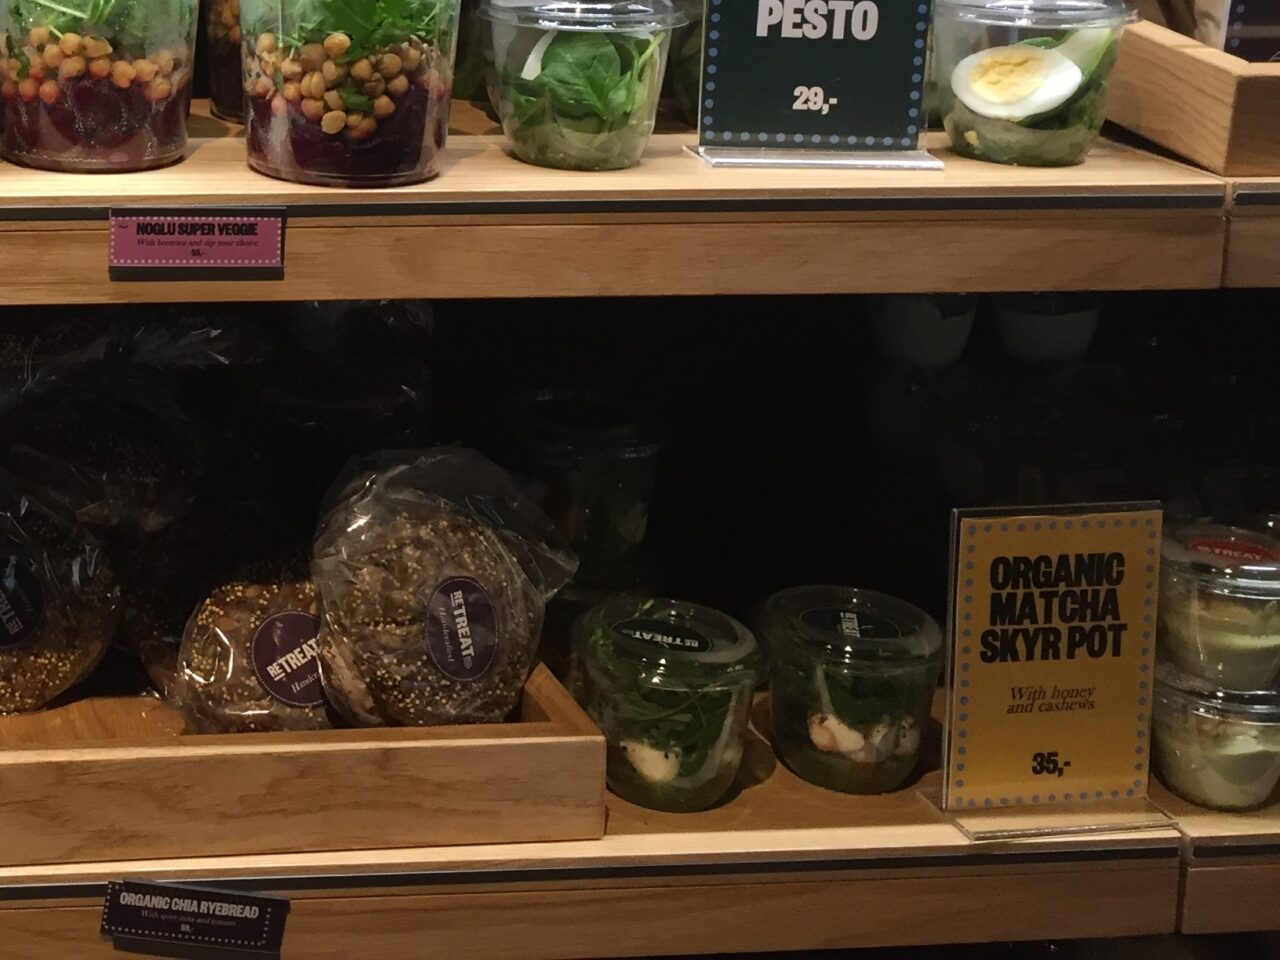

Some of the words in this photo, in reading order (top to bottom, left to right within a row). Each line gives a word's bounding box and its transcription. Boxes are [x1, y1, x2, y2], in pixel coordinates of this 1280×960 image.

[792, 85, 838, 115] 29,-
[136, 222, 176, 236] NOGLU
[177, 222, 216, 236] SUPER
[218, 222, 258, 236] VEGGIE
[989, 552, 1125, 590] ORGANIC
[989, 588, 1121, 626] MATCHA
[450, 590, 475, 657] RETREAT
[980, 625, 1062, 663] SKYR
[1066, 623, 1128, 660] POT
[1006, 700, 1036, 714] and
[1038, 697, 1095, 713] cashews
[1010, 686, 1047, 703] With
[1051, 685, 1096, 701] honey
[1032, 752, 1072, 777] 35,-
[120, 892, 170, 909] ORGANIC
[171, 897, 199, 913] CHIA
[199, 900, 260, 919] RYEBREAD
